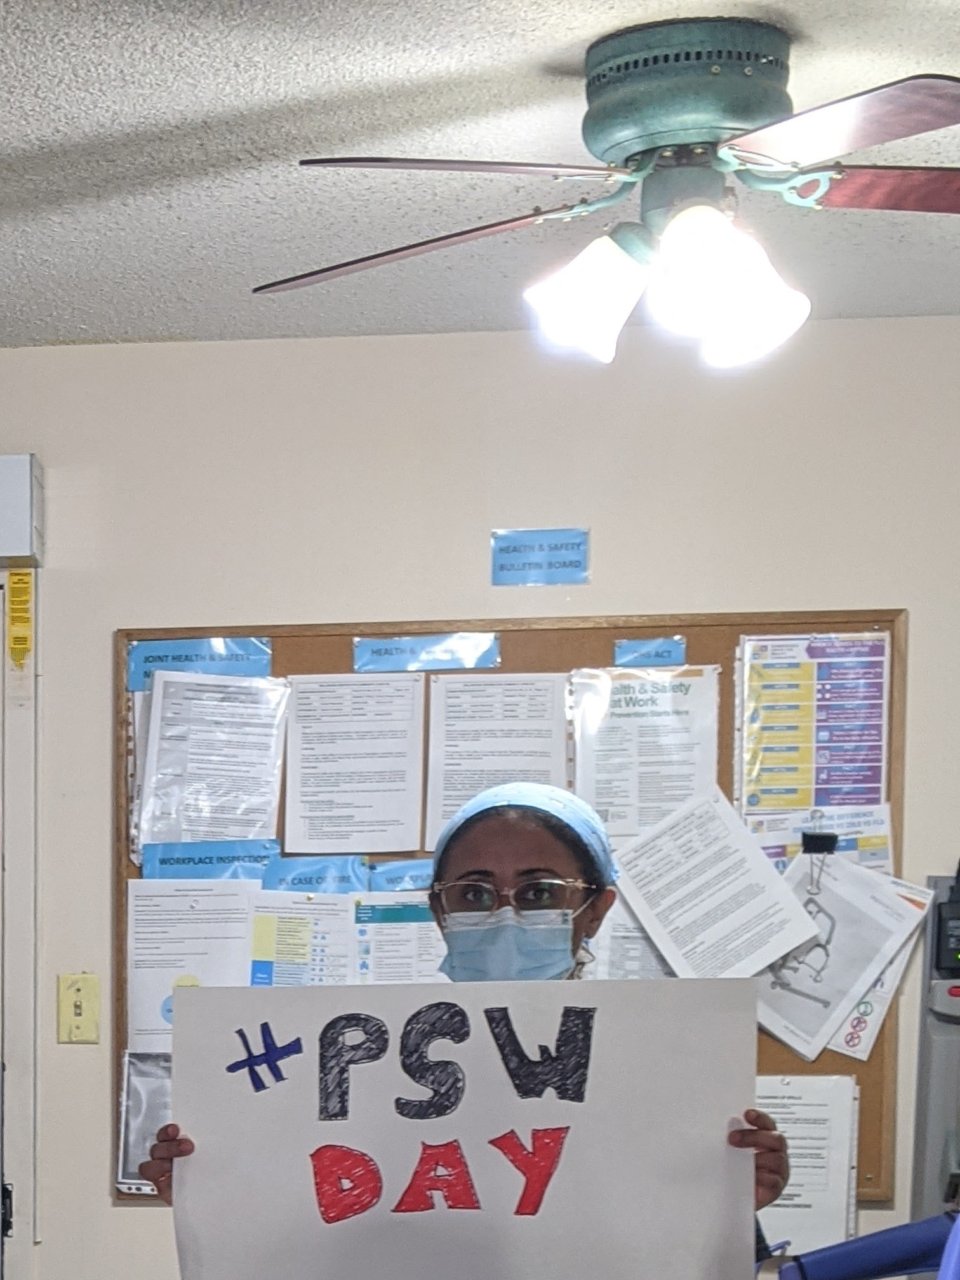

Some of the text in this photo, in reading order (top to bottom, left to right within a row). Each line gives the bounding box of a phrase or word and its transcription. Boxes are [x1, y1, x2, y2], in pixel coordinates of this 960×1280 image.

[547, 560, 582, 570] BOARD
[143, 655, 169, 664] JOINT
[611, 681, 691, 696] alth & Saety
[624, 696, 658, 708] Work
[158, 856, 214, 866] WORKPLACE
[291, 876, 314, 886] CASE
[310, 1126, 570, 1224] DAY
